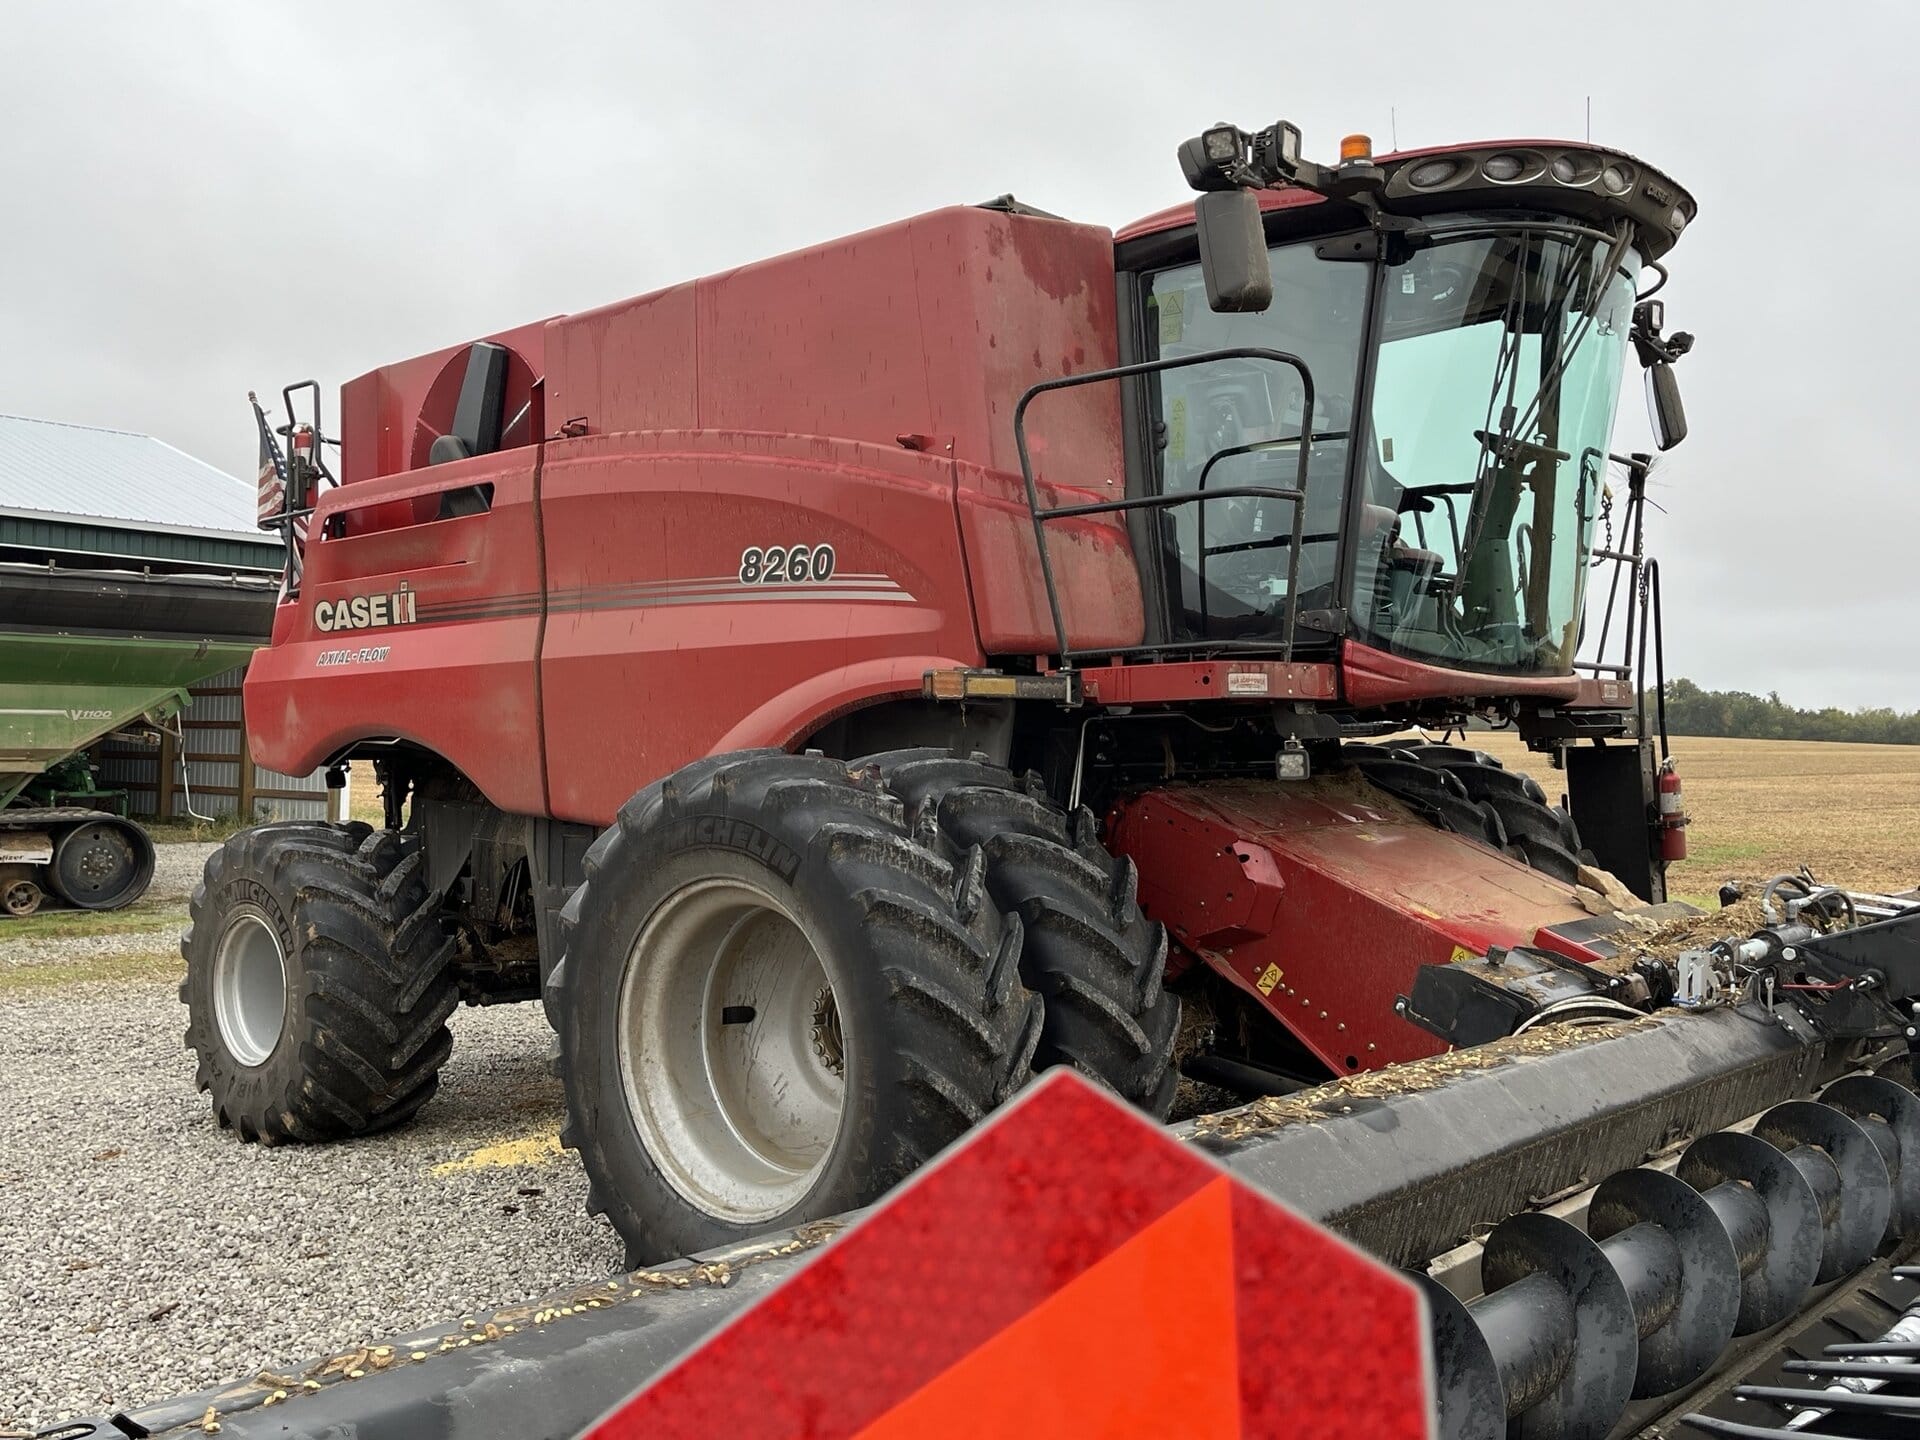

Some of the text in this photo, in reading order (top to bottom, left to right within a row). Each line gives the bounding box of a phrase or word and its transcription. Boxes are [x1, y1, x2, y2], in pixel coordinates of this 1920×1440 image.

[739, 543, 836, 585] 8260
[315, 593, 389, 632] CASE
[316, 646, 391, 667] AXIAL-FLOW
[71, 709, 112, 721] V1100
[663, 815, 800, 878] MICHELIN
[229, 880, 294, 955] MICHELIN
